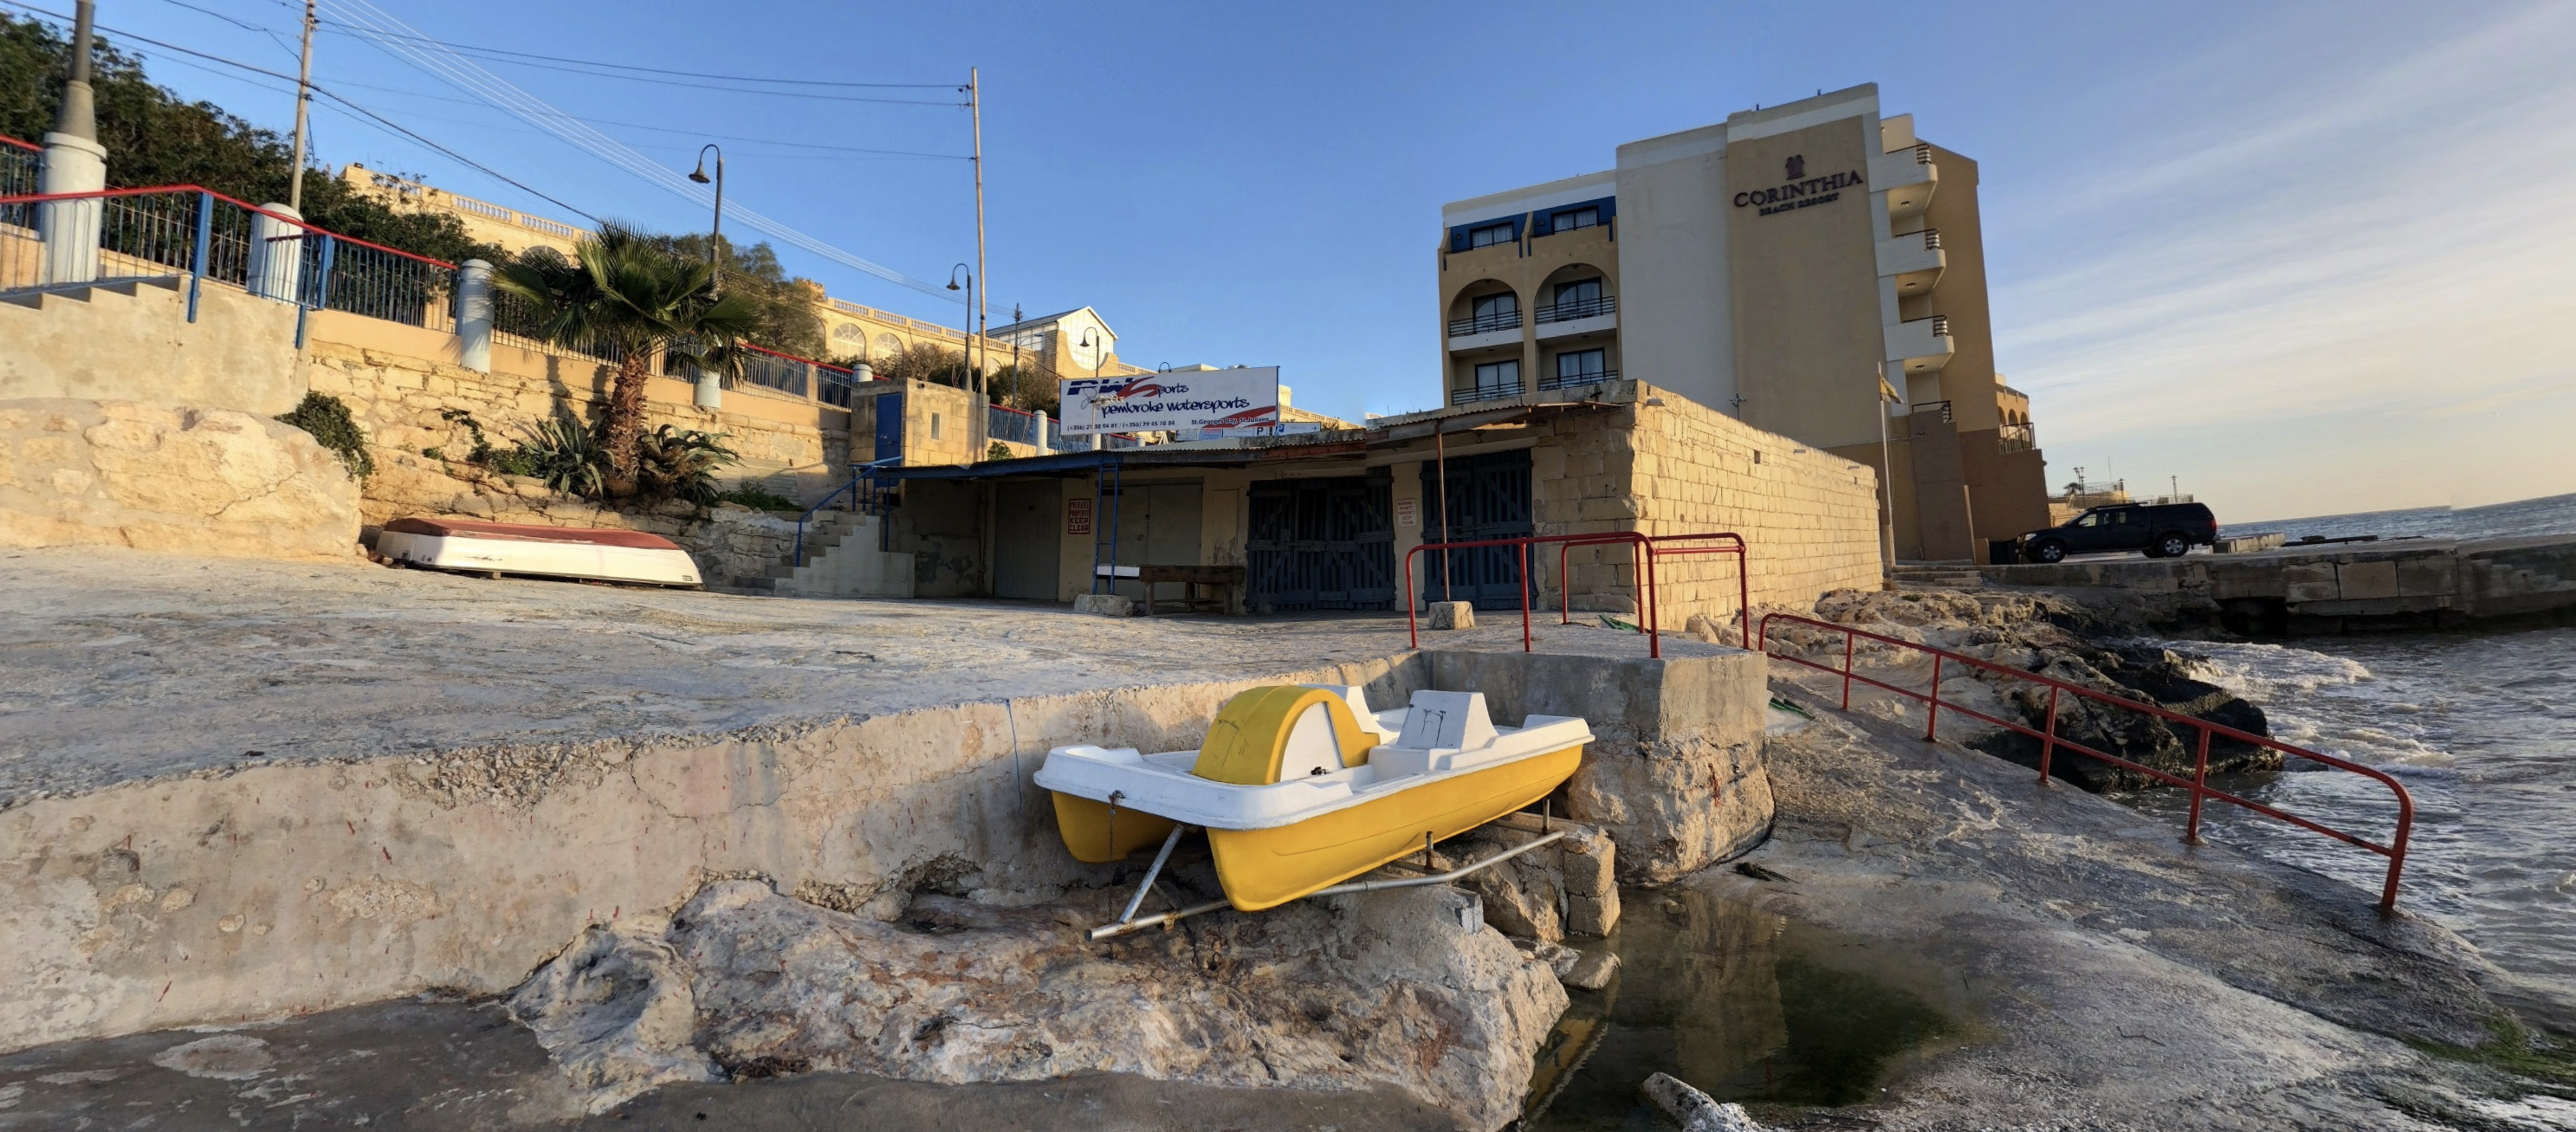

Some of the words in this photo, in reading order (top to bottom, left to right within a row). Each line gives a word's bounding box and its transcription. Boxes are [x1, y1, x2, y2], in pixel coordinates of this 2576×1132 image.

[1734, 170, 1863, 207] CORINTHIA
[1759, 202, 1795, 217] BEACH
[1797, 192, 1840, 208] RESORT
[1102, 401, 1164, 418] pembroke
[1167, 397, 1250, 413] watersports
